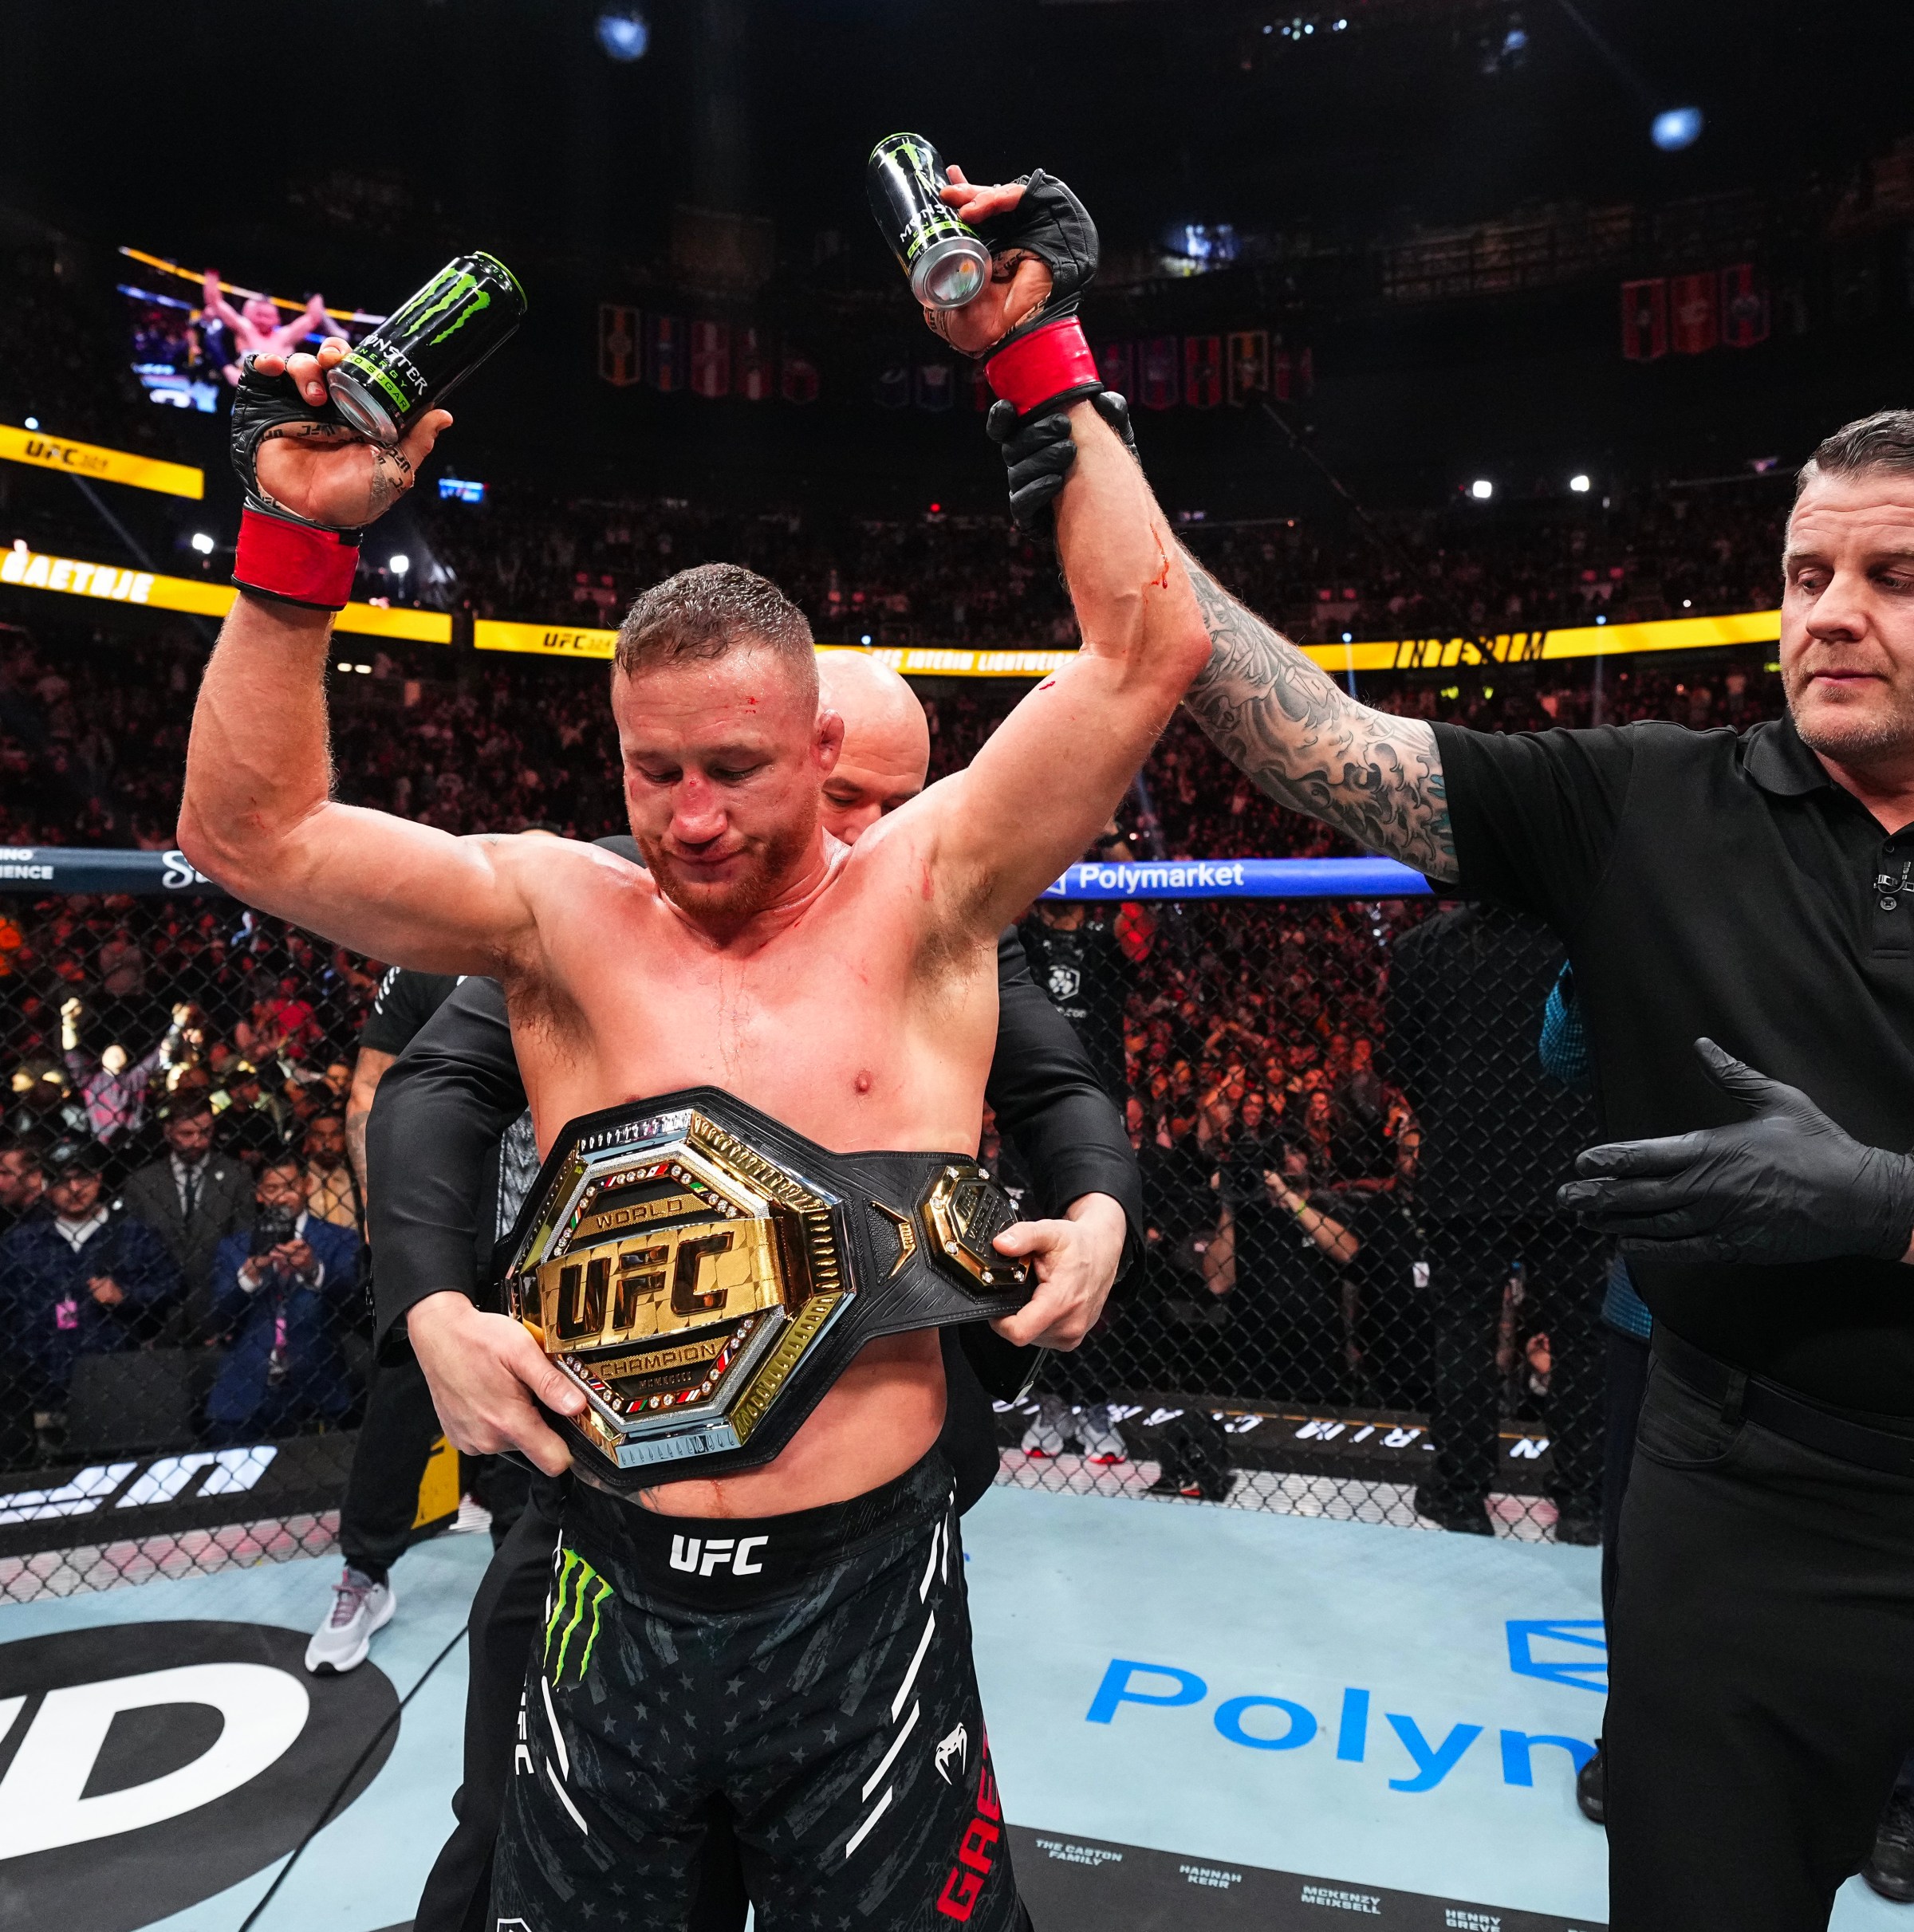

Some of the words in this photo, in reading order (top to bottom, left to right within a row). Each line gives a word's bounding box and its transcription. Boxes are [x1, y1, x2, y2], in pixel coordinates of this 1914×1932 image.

[366, 364, 408, 409] SUGAR
[25, 440, 77, 466] UFC
[543, 632, 586, 651] UFC
[1079, 864, 1244, 894] Polymarket
[597, 1198, 683, 1229] WORLD
[557, 1230, 734, 1340] UFC
[600, 1343, 716, 1377] CHAMPION
[669, 1534, 769, 1576] UFC
[0, 1662, 309, 1860] D
[1036, 1839, 1064, 1851] THE
[1048, 1850, 1103, 1867] FAMILY
[1180, 1864, 1242, 1883] HANNAH
[1187, 1875, 1229, 1889] KERR
[1301, 1895, 1381, 1914] MEIXSELL
[1302, 1885, 1380, 1906] MCKENZY
[1445, 1909, 1502, 1926] HENRY
